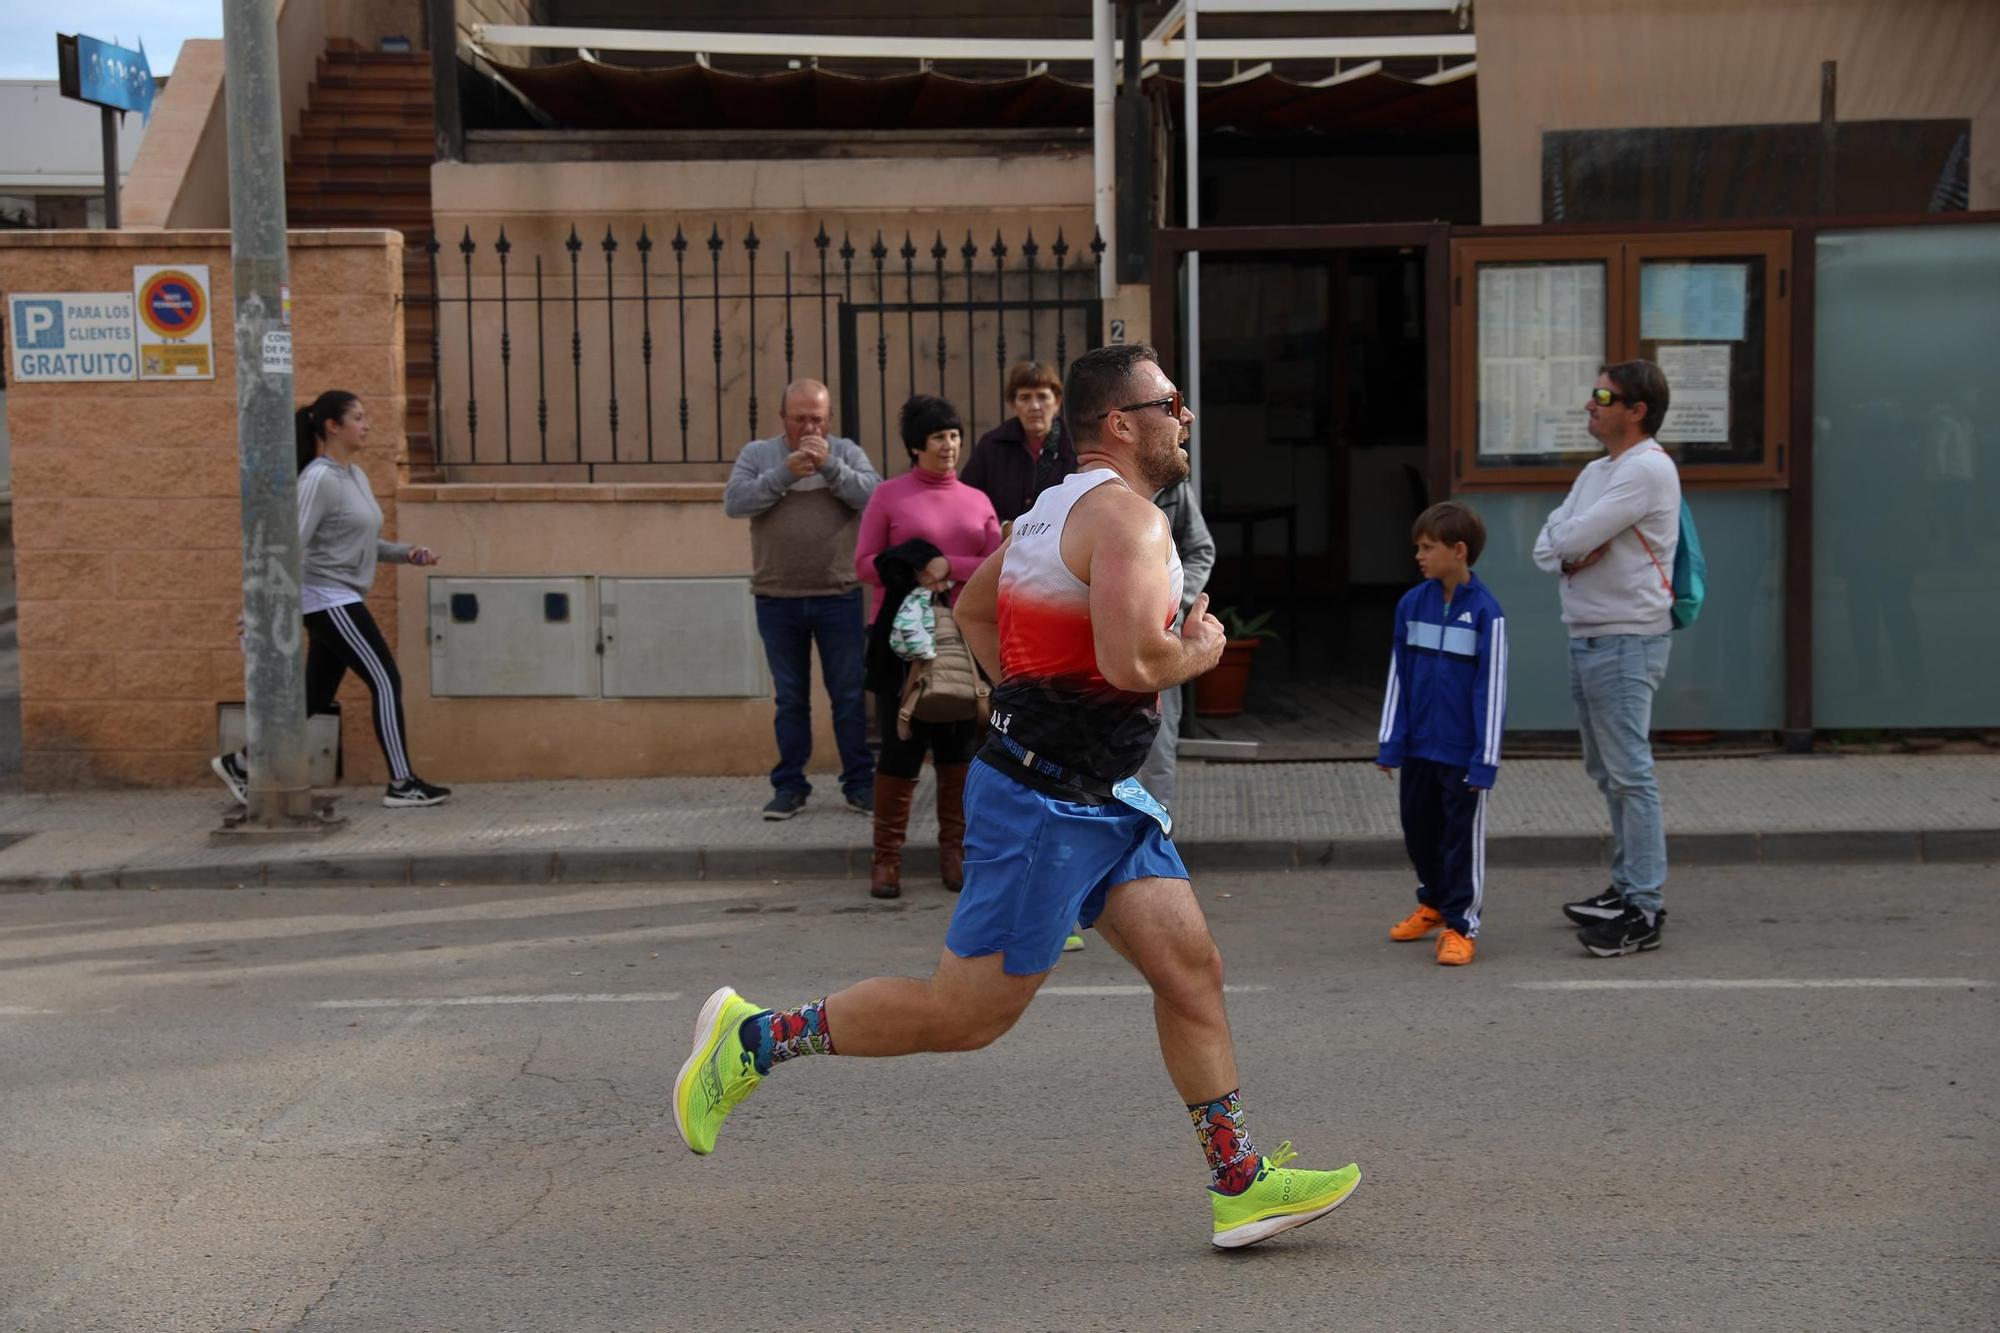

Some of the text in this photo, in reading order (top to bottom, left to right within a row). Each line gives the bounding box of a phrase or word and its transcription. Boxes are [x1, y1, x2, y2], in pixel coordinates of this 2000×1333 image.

[68, 305, 130, 320] PARA LOS
[25, 307, 54, 344] P
[69, 326, 131, 341] CLIENTES
[1112, 321, 1124, 342] 2
[21, 353, 133, 376] GRATUITO
